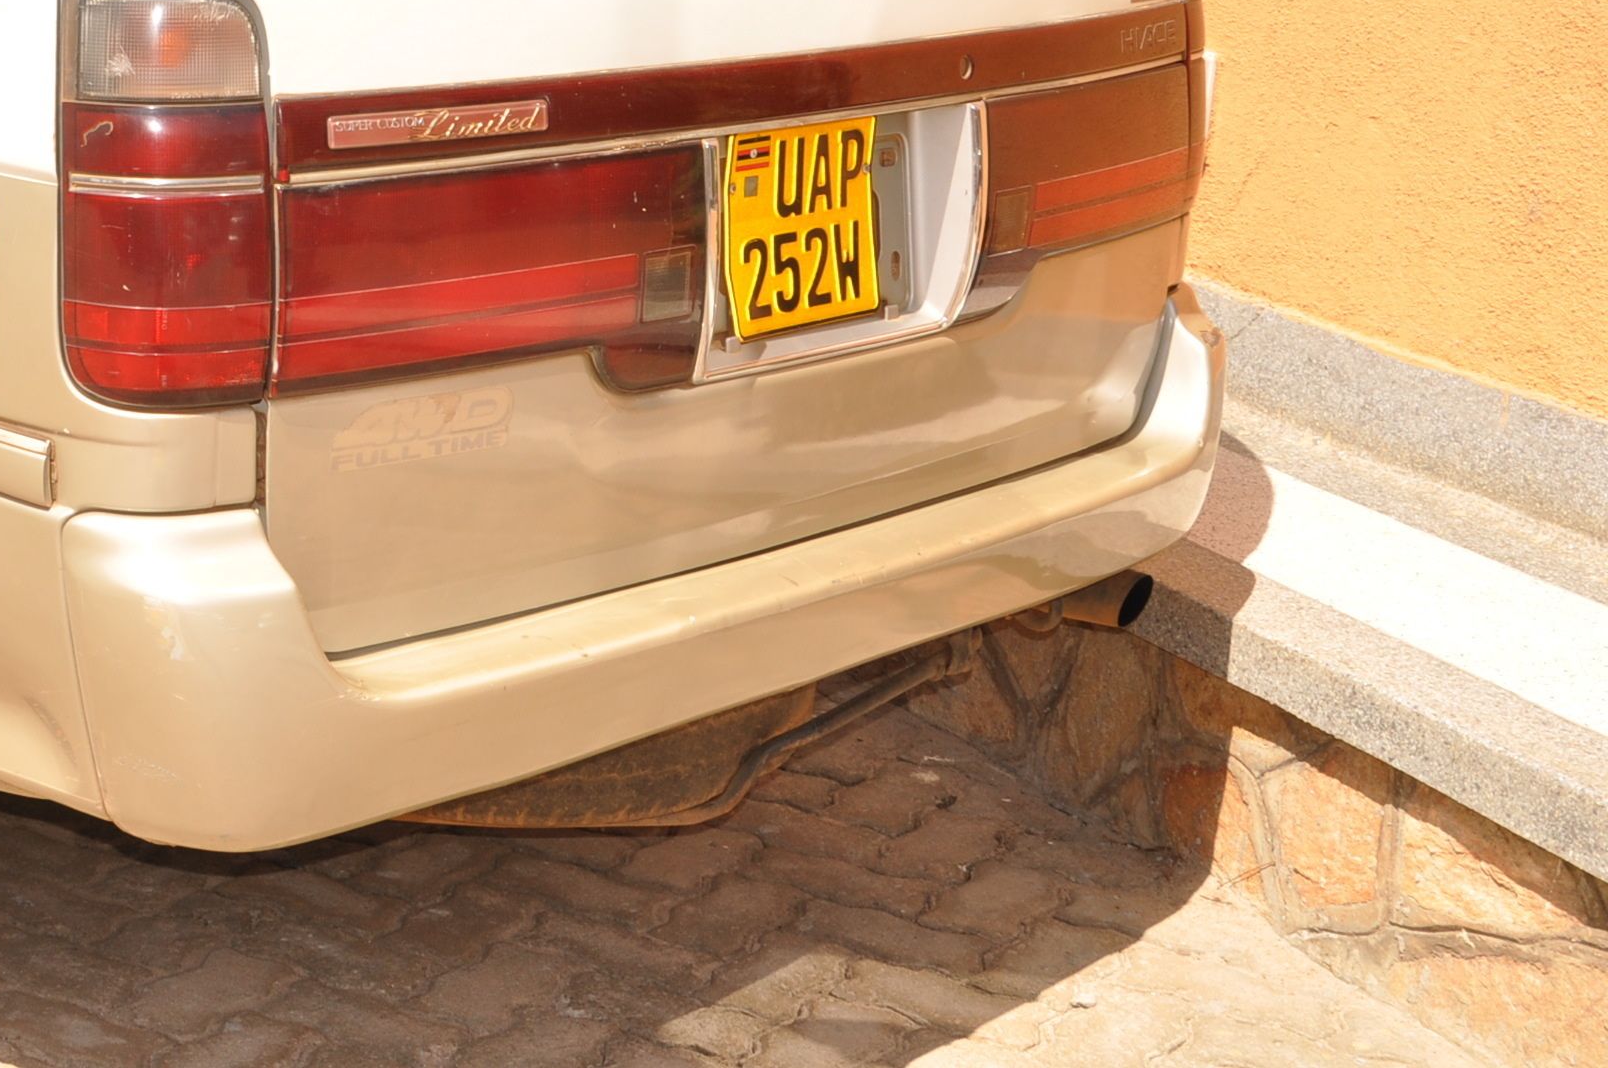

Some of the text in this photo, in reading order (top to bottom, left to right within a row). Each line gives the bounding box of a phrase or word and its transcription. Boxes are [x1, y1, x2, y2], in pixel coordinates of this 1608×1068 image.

[409, 102, 542, 140] Limited
[775, 128, 866, 219] UAP
[741, 220, 862, 322] 252W
[329, 430, 508, 475] FULL TIME
